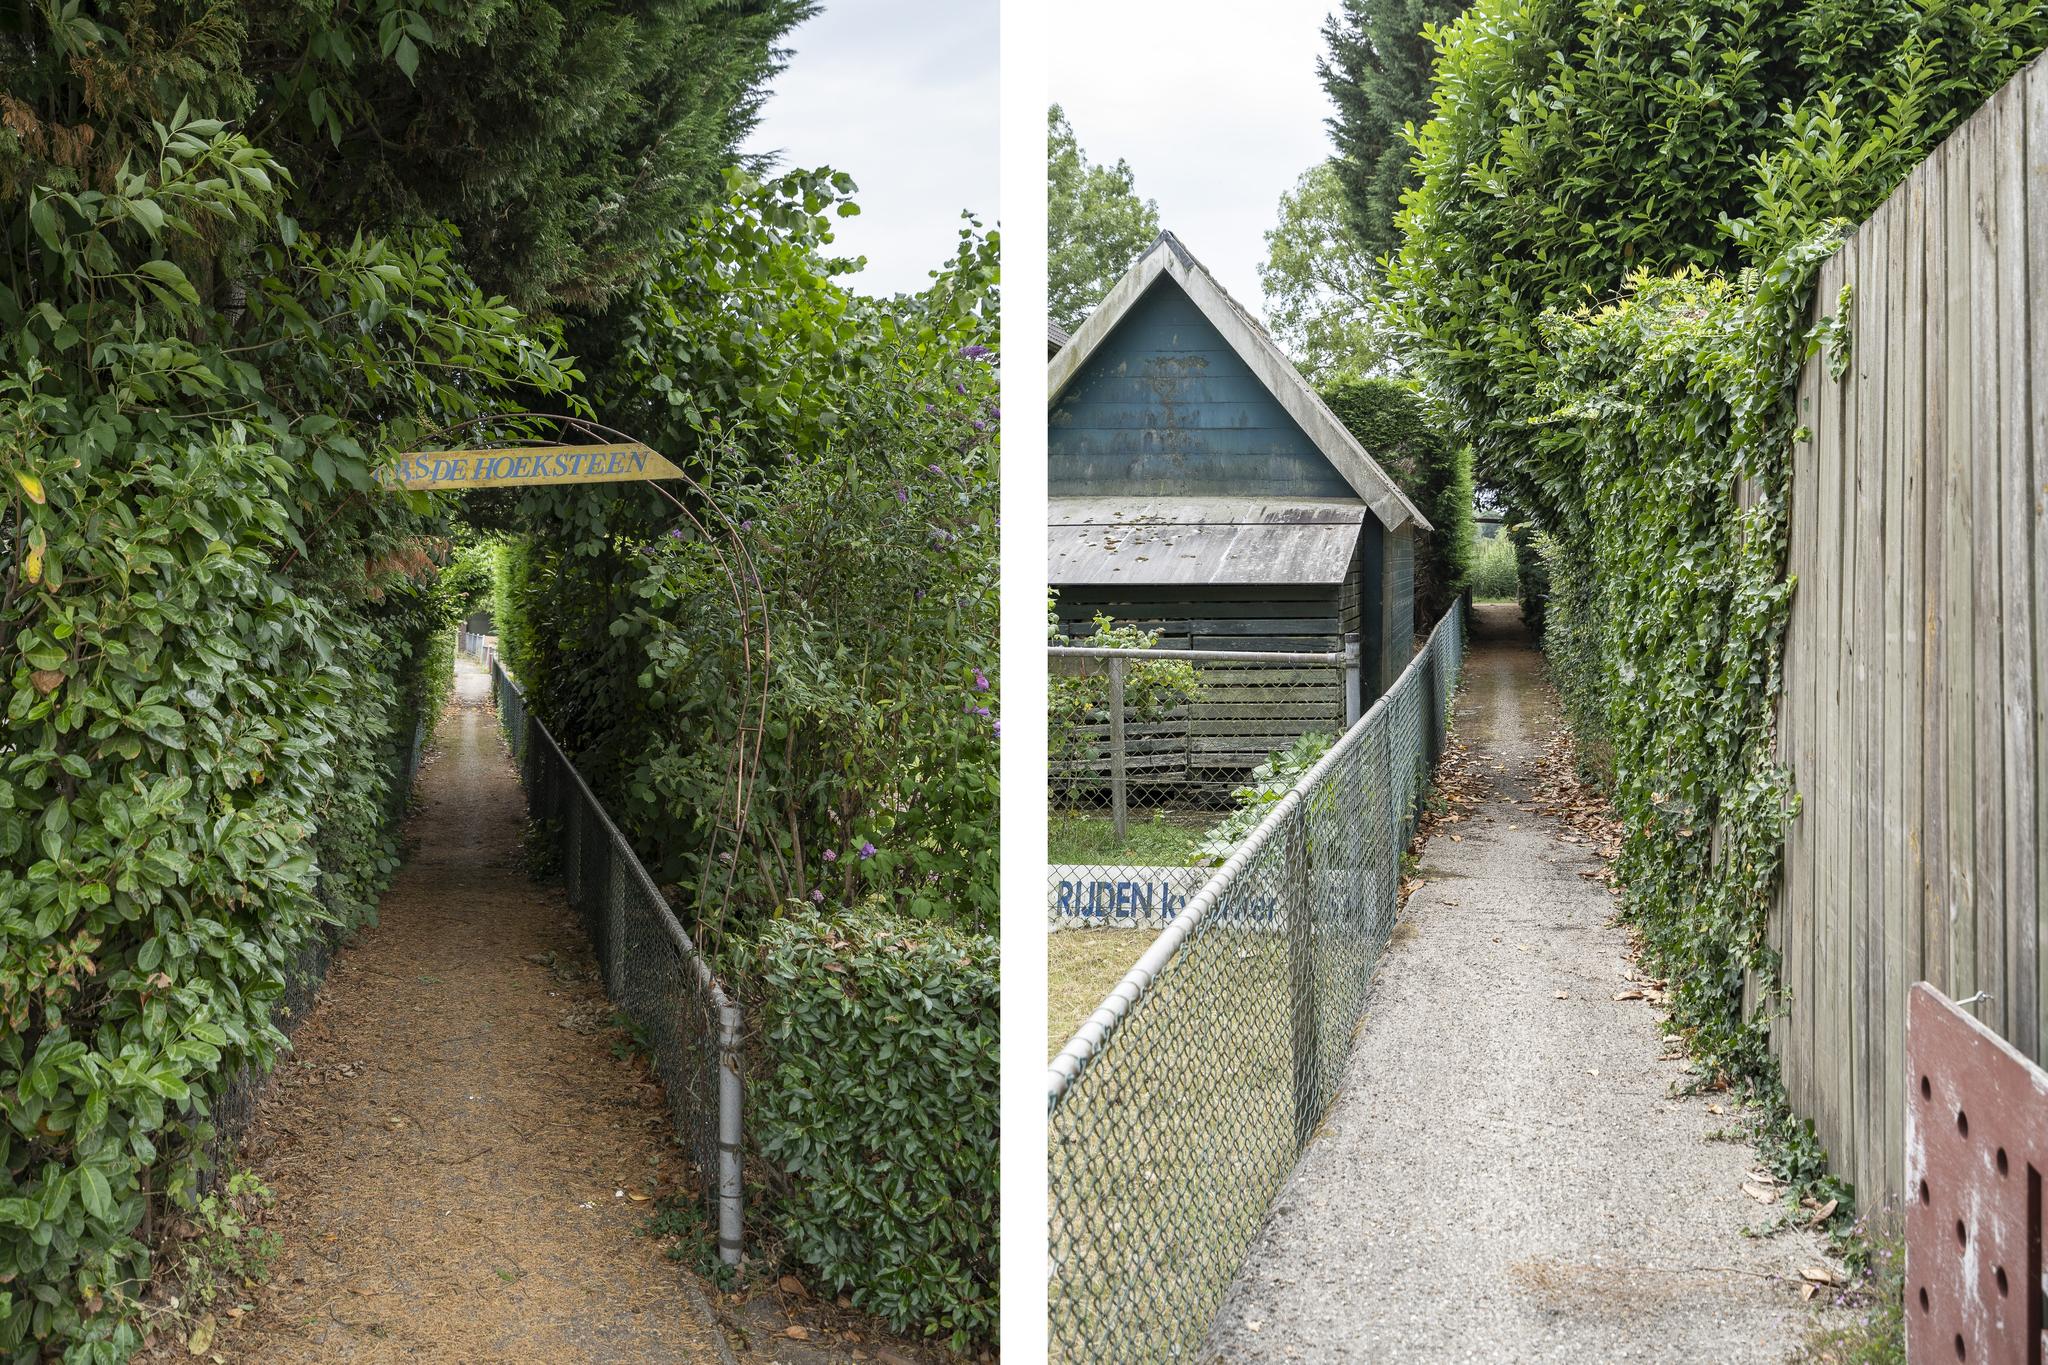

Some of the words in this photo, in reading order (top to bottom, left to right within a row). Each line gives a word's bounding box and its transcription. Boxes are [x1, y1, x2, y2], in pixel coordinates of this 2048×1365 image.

[430, 458, 468, 481] DE
[471, 450, 650, 481] HOEKSTEEN
[1057, 880, 1153, 919] RIJDEN
